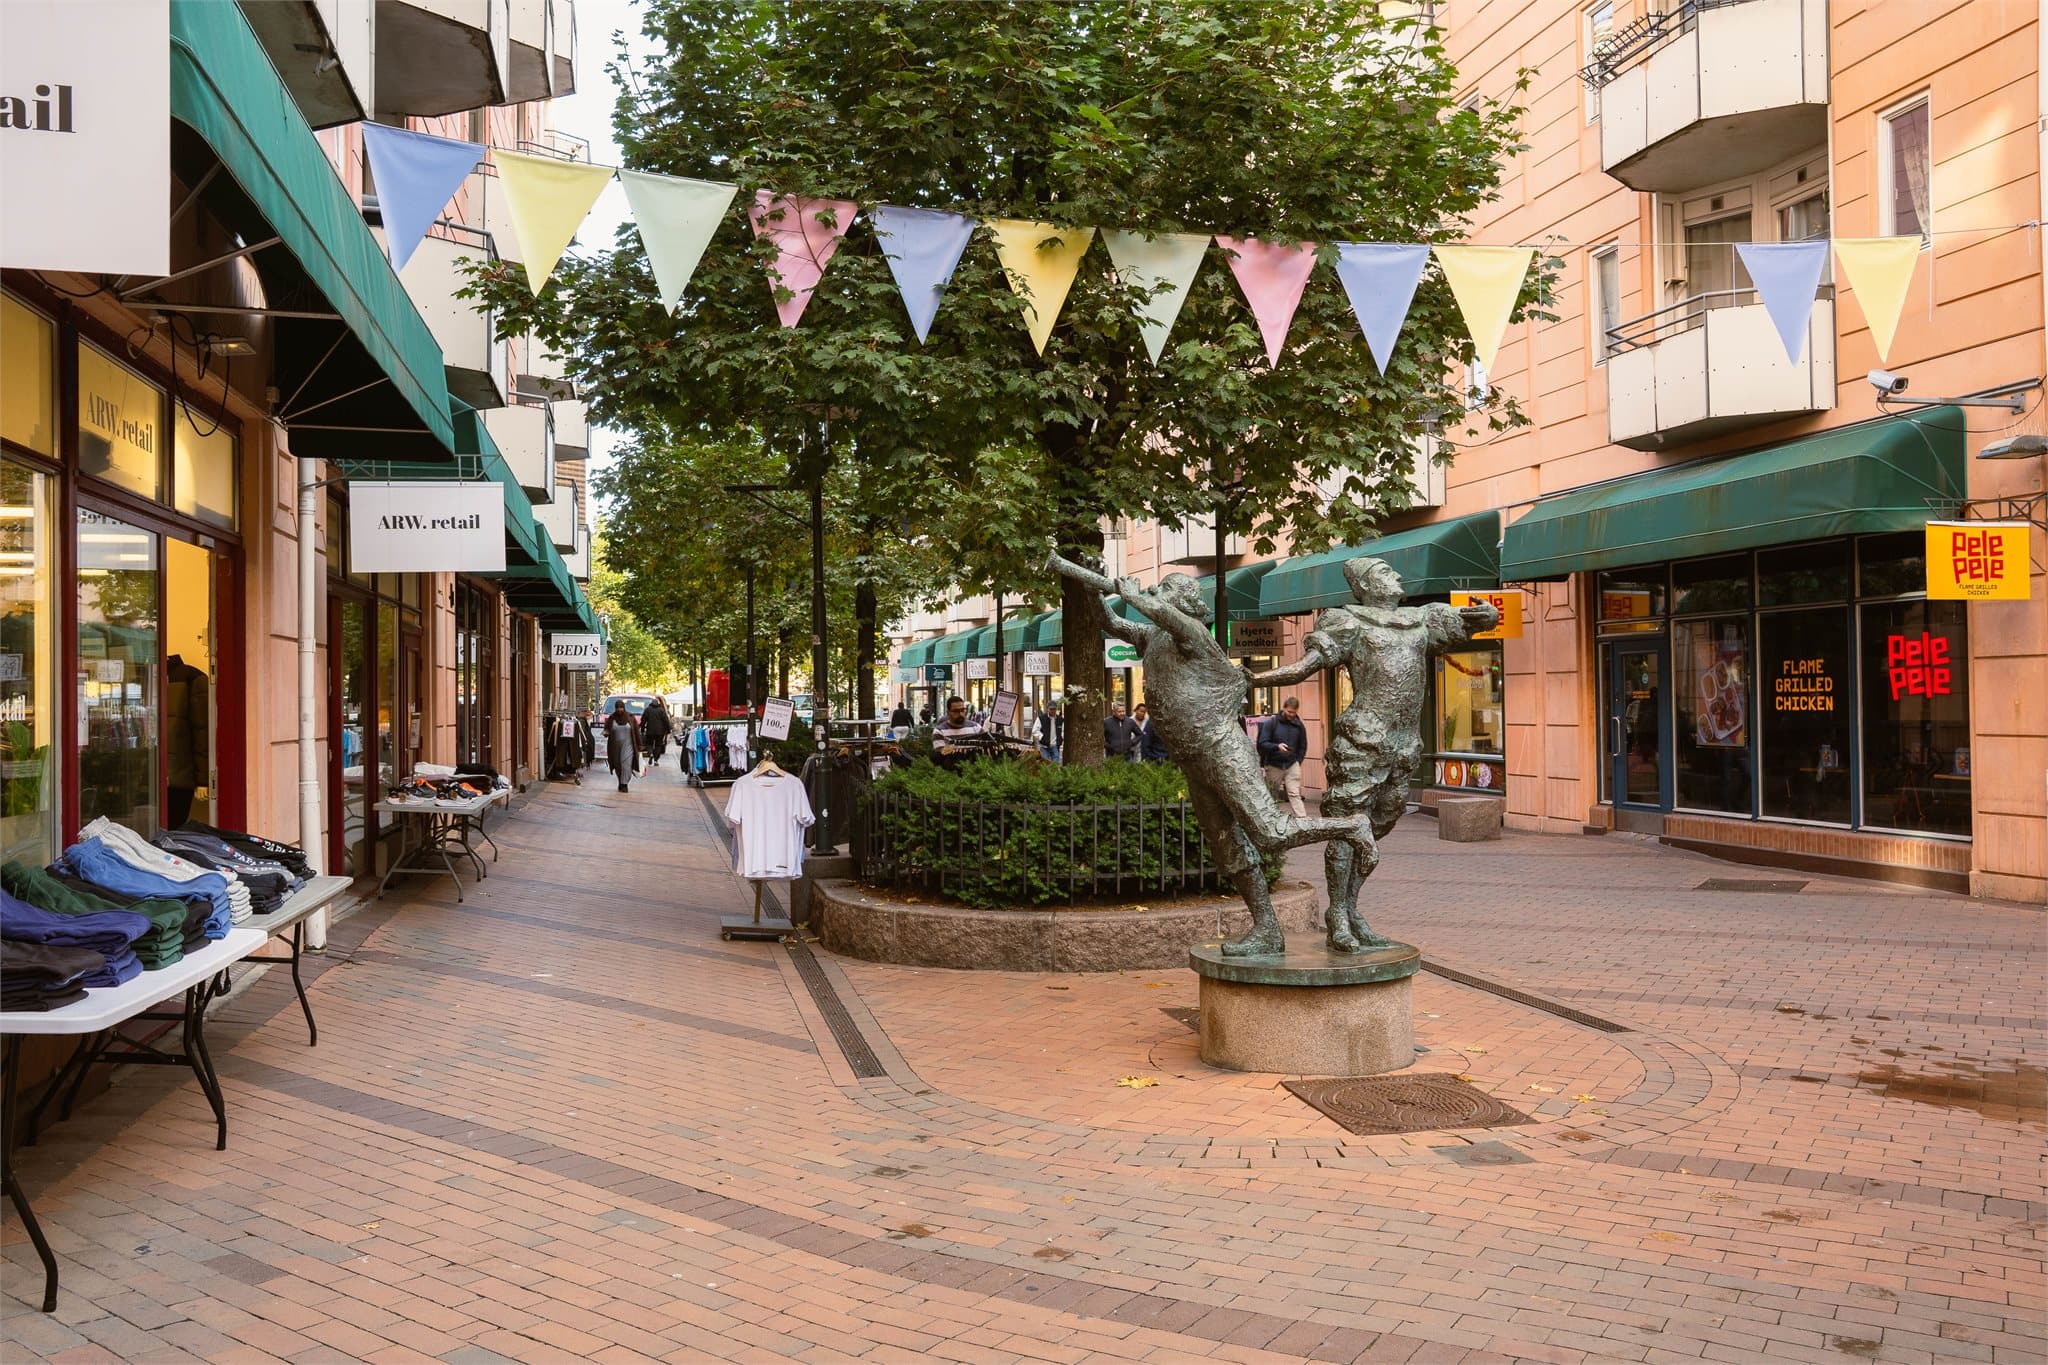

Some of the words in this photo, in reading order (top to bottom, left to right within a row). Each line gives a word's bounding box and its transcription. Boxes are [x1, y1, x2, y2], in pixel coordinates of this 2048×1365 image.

[86, 391, 121, 437] ARW.
[122, 418, 153, 454] retail
[377, 514, 428, 530] ARW.
[431, 513, 481, 530] retail
[1782, 659, 1825, 675] FLAME
[1775, 677, 1833, 692] GRILLED
[1775, 696, 1834, 711] CHICKEN
